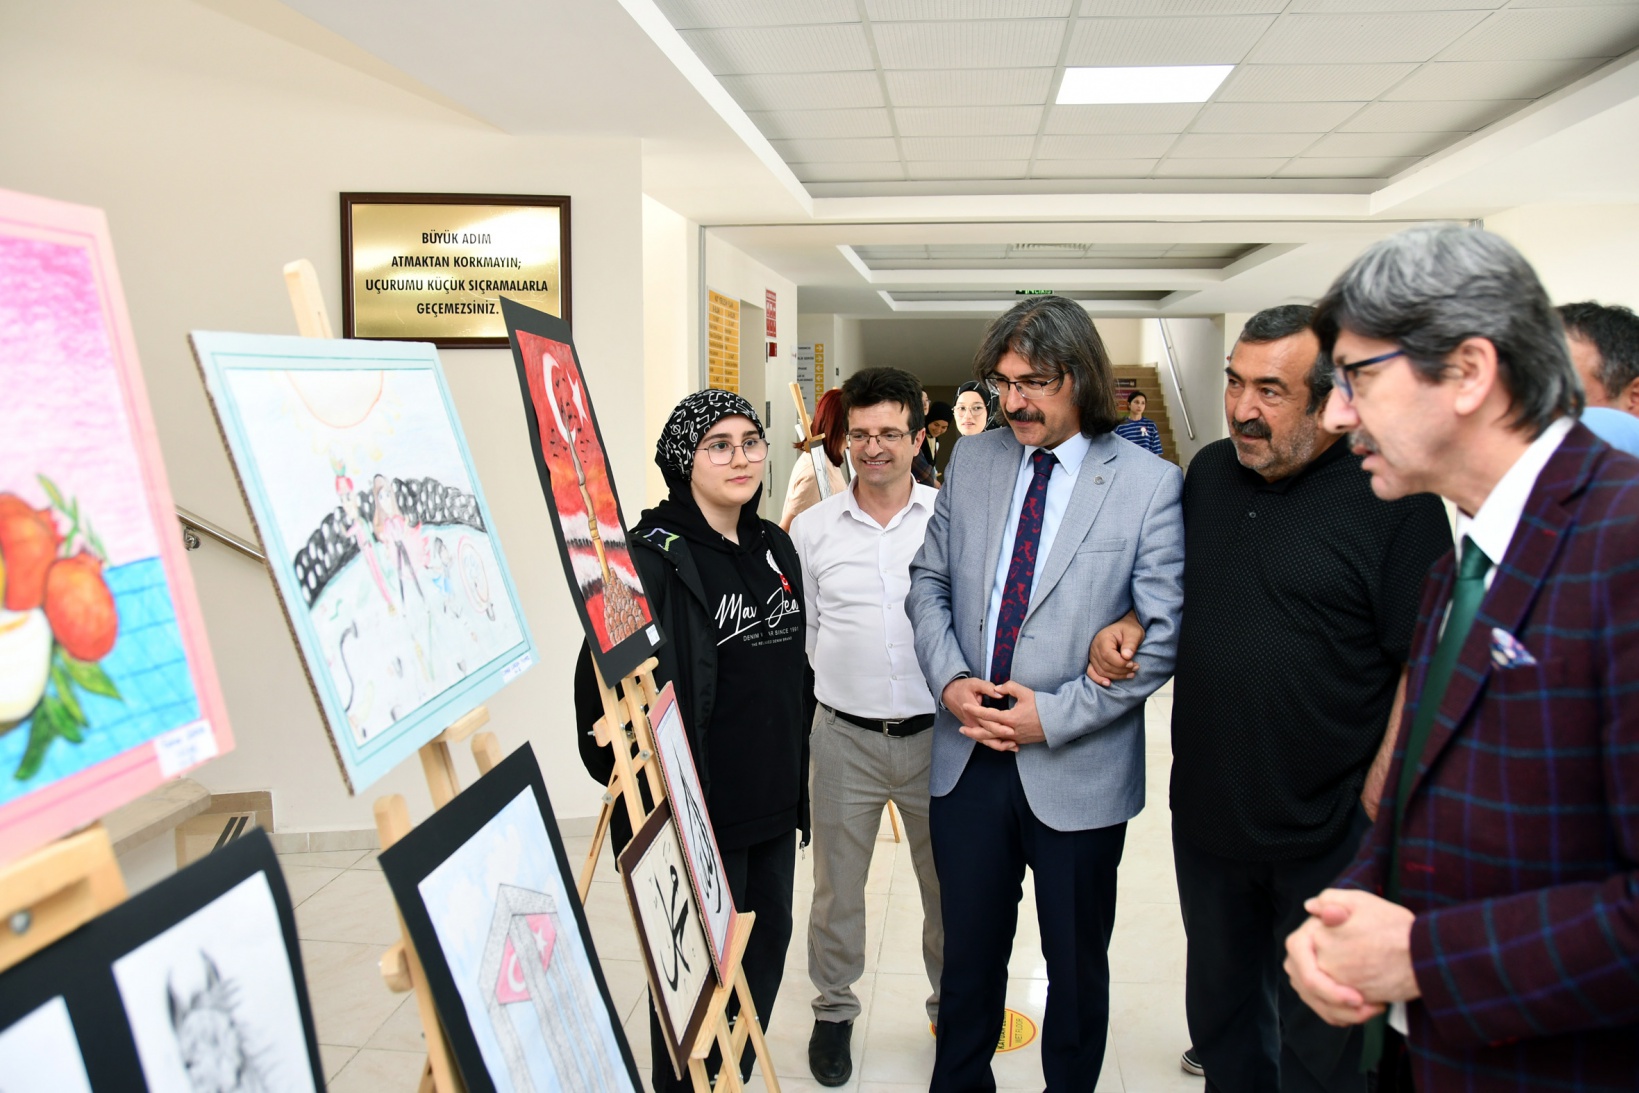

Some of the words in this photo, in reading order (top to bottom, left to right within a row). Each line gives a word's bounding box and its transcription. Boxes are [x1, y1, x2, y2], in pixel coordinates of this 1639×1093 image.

[422, 229, 459, 244] BÜYÜK
[462, 233, 492, 244] ADIM
[391, 256, 450, 268] ATMAKTAN
[453, 256, 522, 270] KORKMAYIN;
[365, 279, 424, 294] UÇURUMU
[427, 276, 466, 294] KÜÇÜK
[469, 279, 549, 294] SIÇRAMALARLA
[416, 299, 500, 317] GEÇEMEZSİNİZ.
